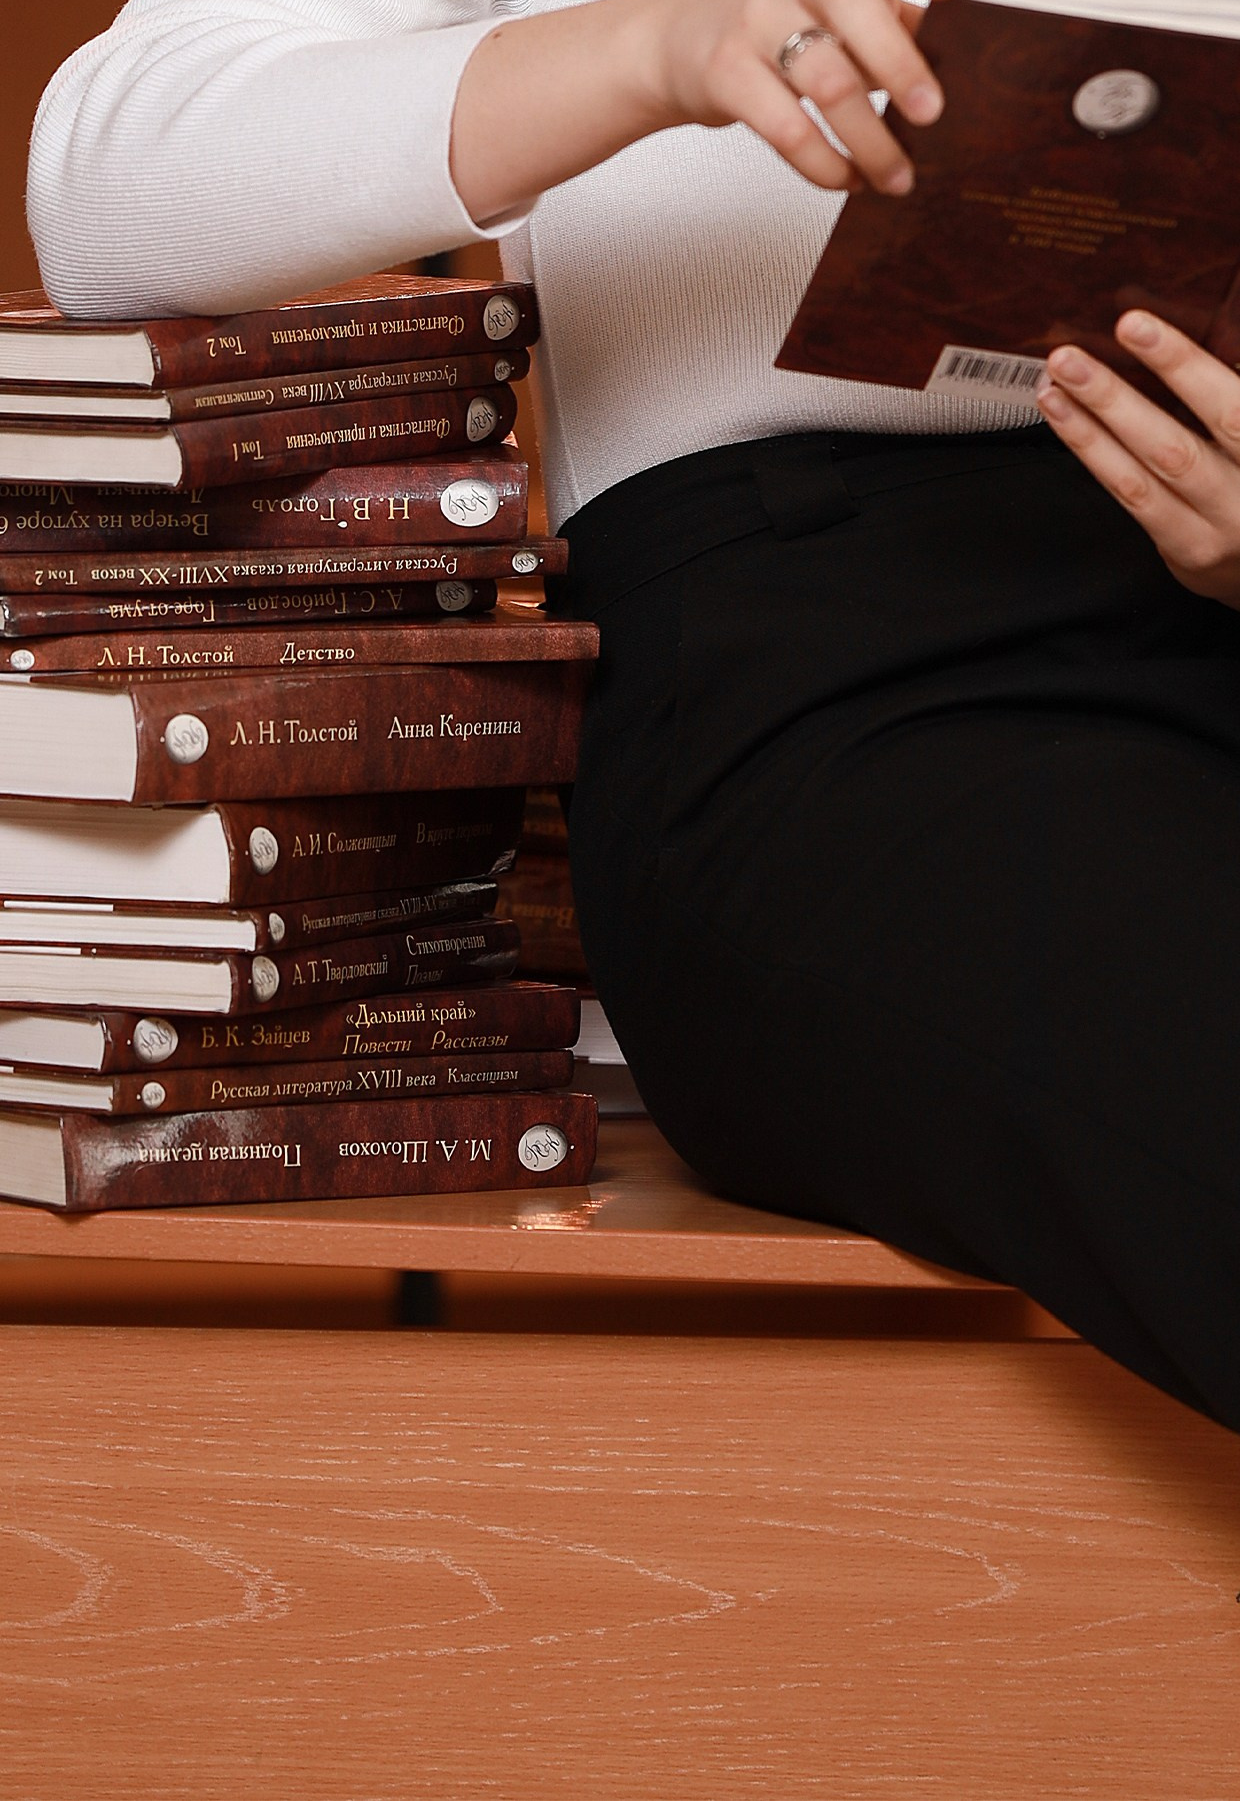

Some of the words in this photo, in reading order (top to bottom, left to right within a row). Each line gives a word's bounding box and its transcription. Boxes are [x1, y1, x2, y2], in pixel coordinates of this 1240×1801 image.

[270, 318, 366, 346] приключения
[368, 321, 379, 336] и
[381, 314, 466, 337] Фантастика
[206, 337, 218, 358] 2
[219, 335, 248, 357] Том
[347, 372, 412, 393] литература
[412, 364, 458, 388] Русская
[194, 389, 276, 410] Сентиментализм
[281, 386, 308, 400] века
[308, 379, 347, 404] XVIII
[285, 422, 367, 451] приключения
[368, 426, 378, 440] и
[379, 416, 452, 441] Фантастика
[241, 439, 265, 462] Том
[15, 510, 91, 531] хуторе
[251, 494, 337, 523] Гоголь
[378, 495, 412, 522] Н.
[98, 513, 124, 530] на
[130, 508, 210, 537] Вечера
[47, 568, 79, 586] Том
[90, 568, 136, 581] веков
[138, 564, 231, 587] XVIII-XX
[232, 563, 284, 577] сказка
[286, 557, 391, 579] литературная
[394, 554, 459, 576] Русская
[33, 569, 44, 587] 2
[108, 598, 145, 620] ума
[148, 601, 170, 618] от
[173, 596, 216, 624] Горе
[246, 587, 347, 615] Грибоедов
[352, 588, 377, 614] С.
[379, 587, 405, 611] А.
[96, 645, 123, 667] Л.
[126, 645, 152, 666] Н.
[156, 644, 236, 666] Толстой
[279, 641, 356, 666] Детство
[229, 720, 254, 746] Л.
[257, 720, 282, 745] Н.
[283, 718, 360, 744] Толстой
[386, 714, 435, 740] Анна
[438, 712, 523, 742] Каренина
[290, 834, 307, 859] А.
[308, 832, 324, 857] И.
[326, 830, 400, 855] Солженицын
[415, 821, 427, 846] В
[302, 912, 331, 935] Русская
[404, 933, 487, 957] Стихотворения
[292, 963, 306, 987] А.
[307, 960, 321, 984] Т.
[321, 954, 390, 985] Твардовский
[404, 963, 444, 987] Поэмы
[345, 1001, 427, 1029] «Дальний
[430, 1000, 477, 1026] край»
[201, 1026, 220, 1049] Б.
[225, 1026, 246, 1048] К.
[251, 1023, 311, 1049] Зайцев
[341, 1033, 413, 1056] Повести
[430, 1029, 510, 1051] Рассказы
[210, 1079, 270, 1104] Русская
[272, 1077, 353, 1099] литература
[354, 1068, 403, 1092] XVIII
[404, 1073, 437, 1089] века
[446, 1067, 519, 1085] Классицизм
[138, 1140, 202, 1163] целина
[208, 1141, 302, 1168] Поднятая
[338, 1139, 429, 1165] Шолохов
[434, 1138, 459, 1163] А.
[464, 1137, 494, 1163] М.
